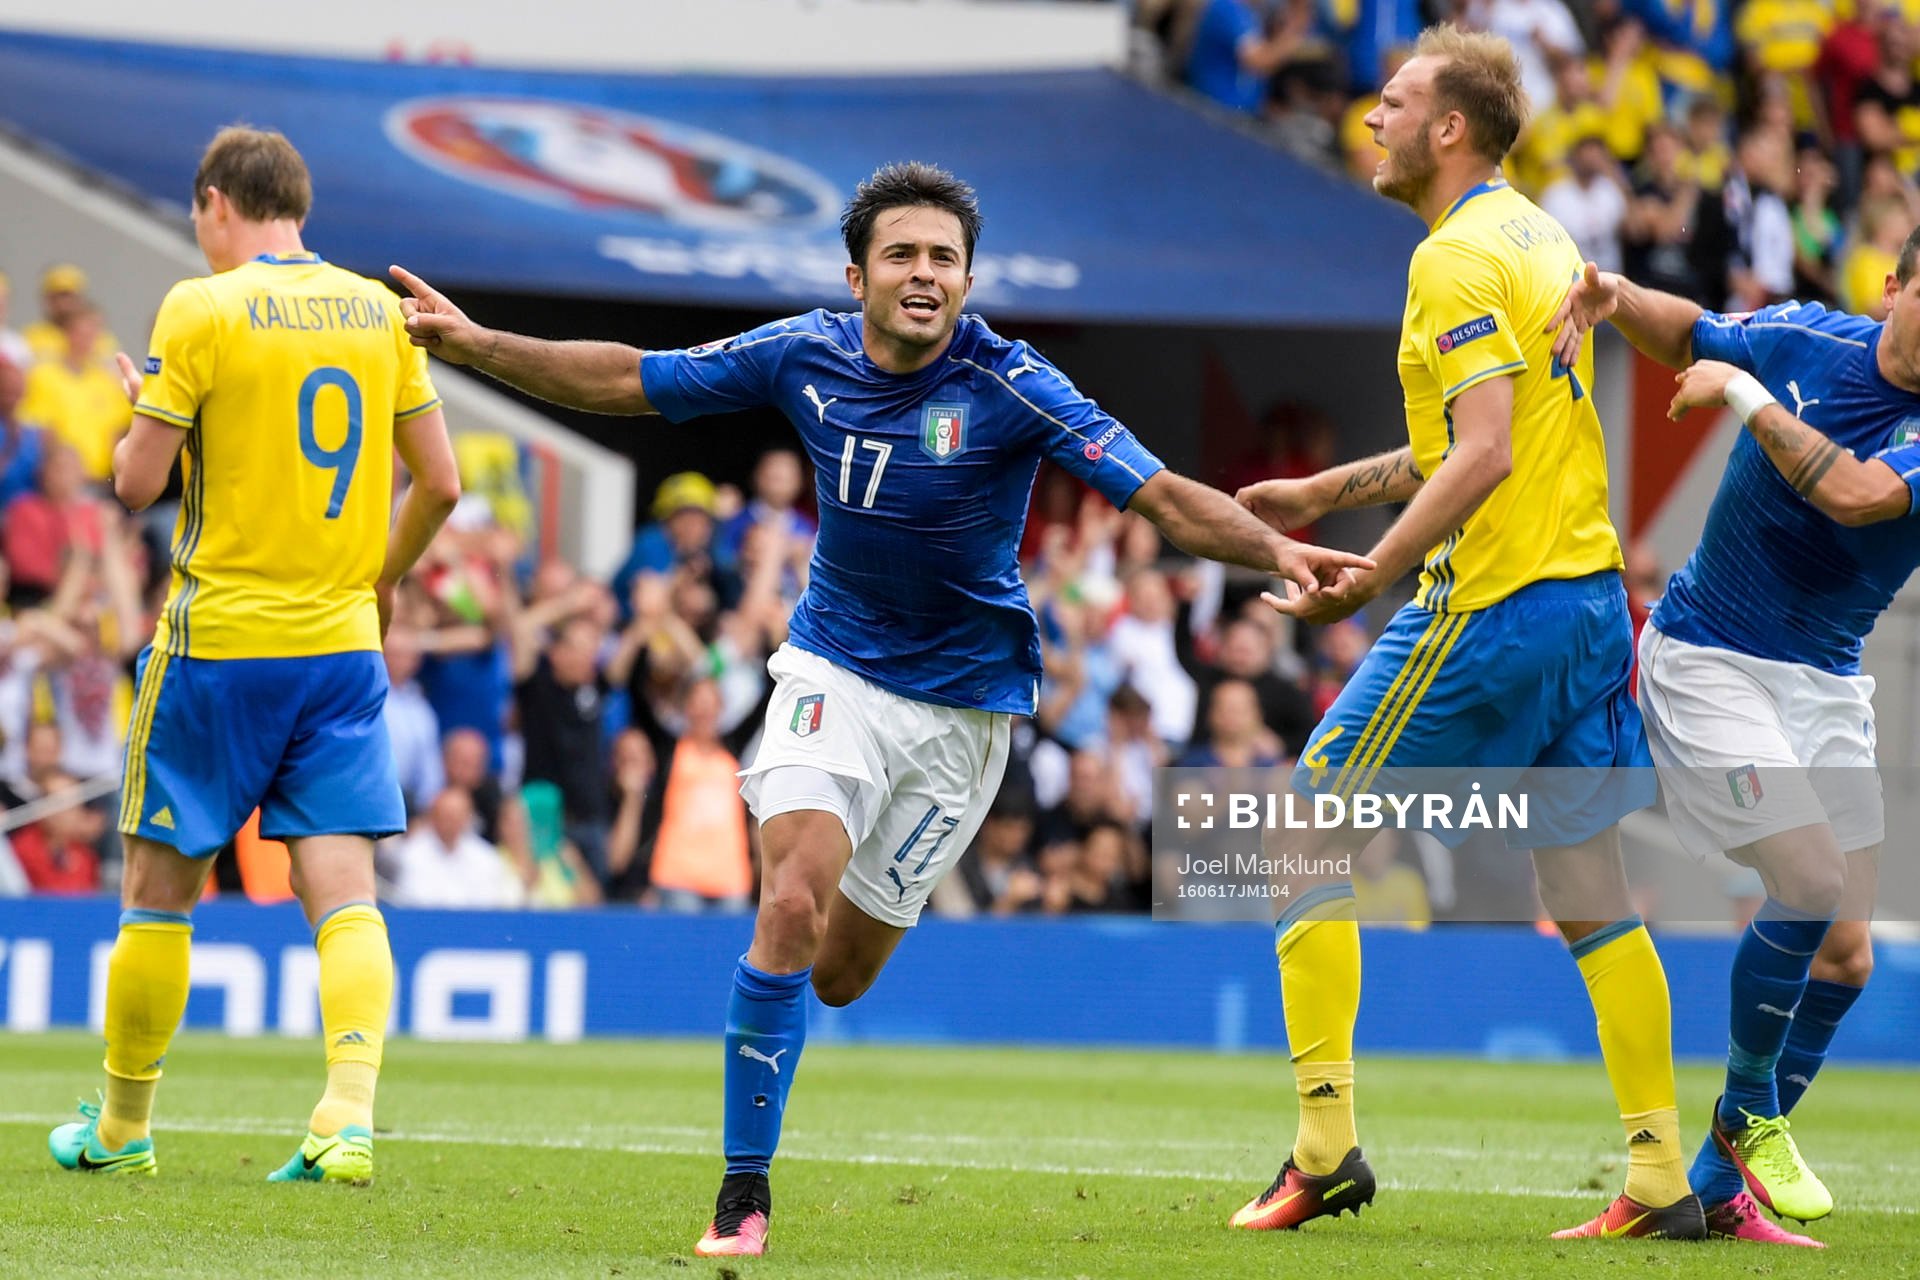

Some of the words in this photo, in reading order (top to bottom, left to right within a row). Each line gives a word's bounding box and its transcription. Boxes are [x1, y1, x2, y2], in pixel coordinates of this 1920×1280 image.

[245, 287, 389, 332] KÄLLSTRÖM
[1452, 318, 1495, 343] RESPECT
[298, 366, 362, 519] 9
[839, 434, 893, 509] 17
[1304, 725, 1345, 789] 4
[894, 804, 960, 875] 17
